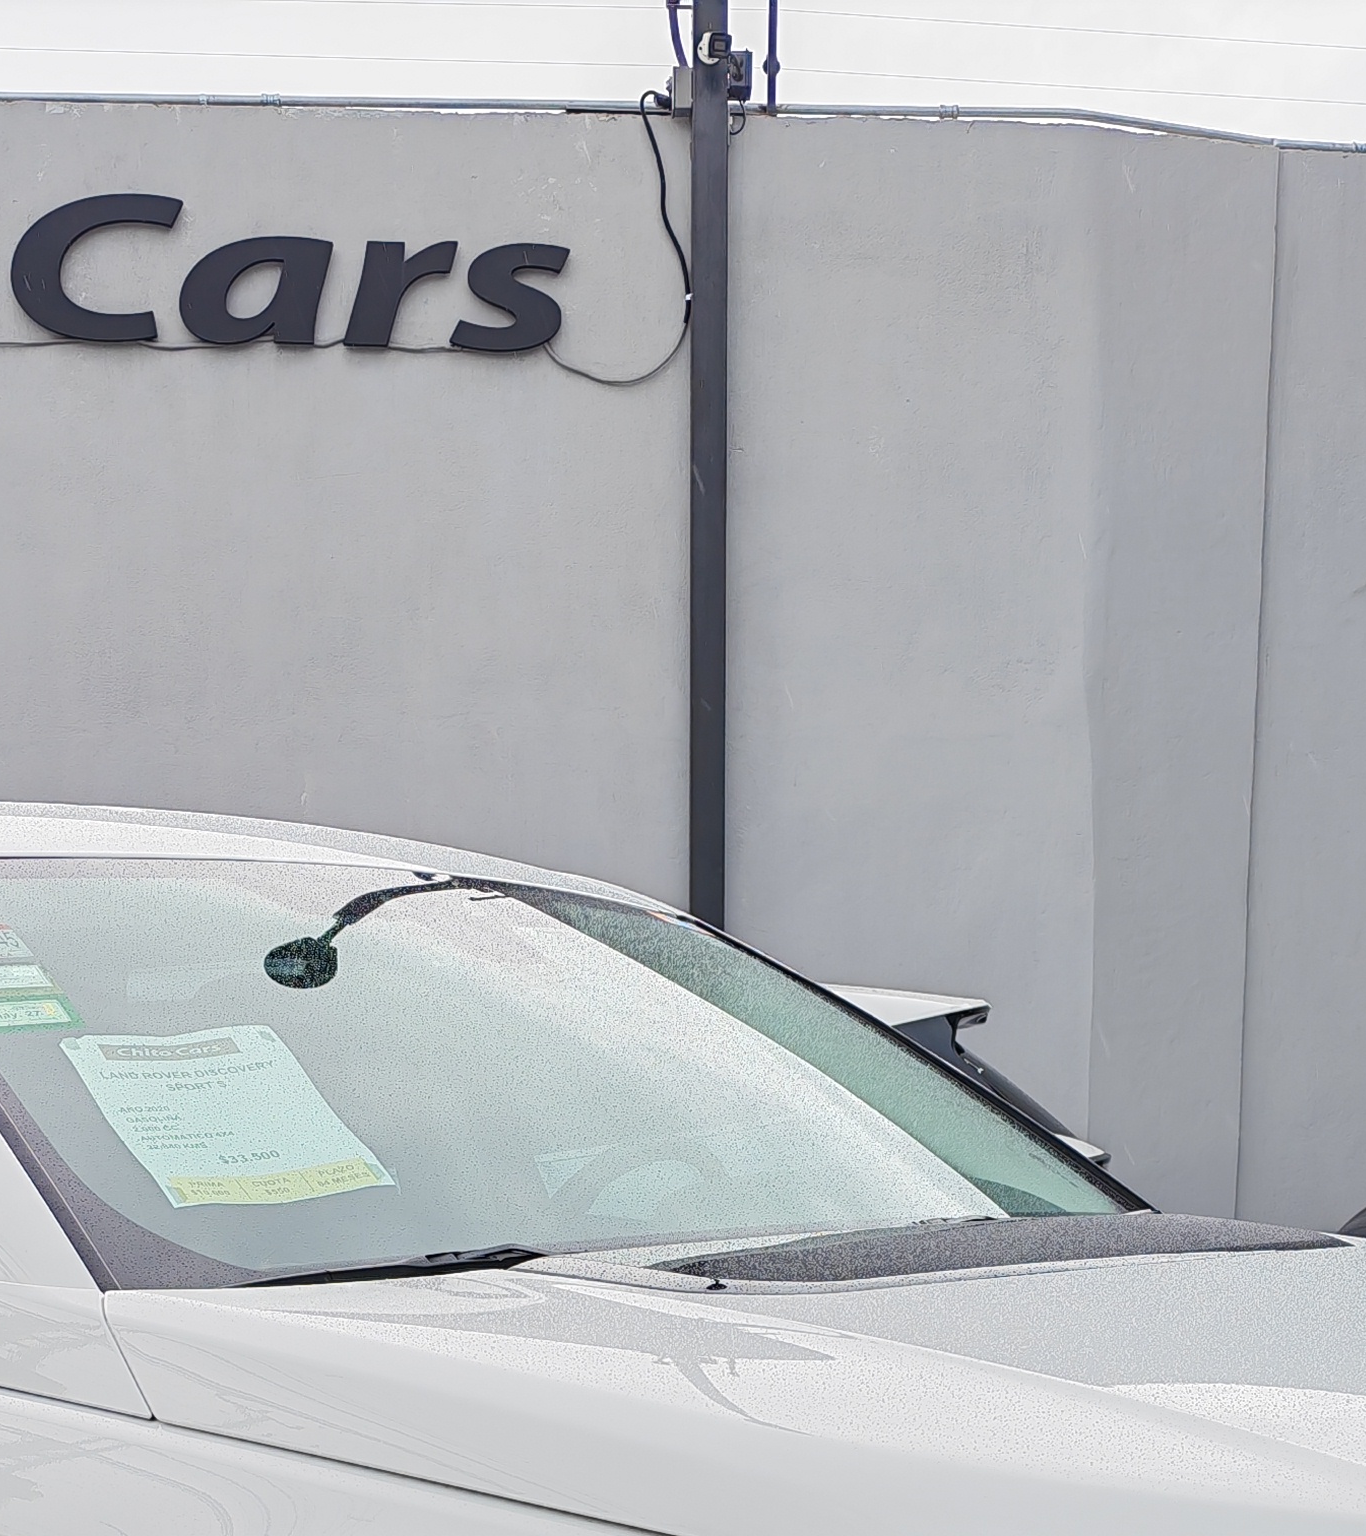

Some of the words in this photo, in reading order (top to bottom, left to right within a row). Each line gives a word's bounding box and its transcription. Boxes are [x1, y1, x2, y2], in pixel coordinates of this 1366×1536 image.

[10, 193, 571, 353] Cars
[116, 1046, 172, 1058] Chito
[175, 1043, 222, 1056] Cars
[99, 1071, 139, 1080] LAND
[142, 1071, 193, 1080] ROVER
[194, 1060, 275, 1079] DISCOVERY
[165, 1081, 214, 1092] SPORT
[216, 1080, 228, 1088] S
[318, 1164, 355, 1177] PLAZO
